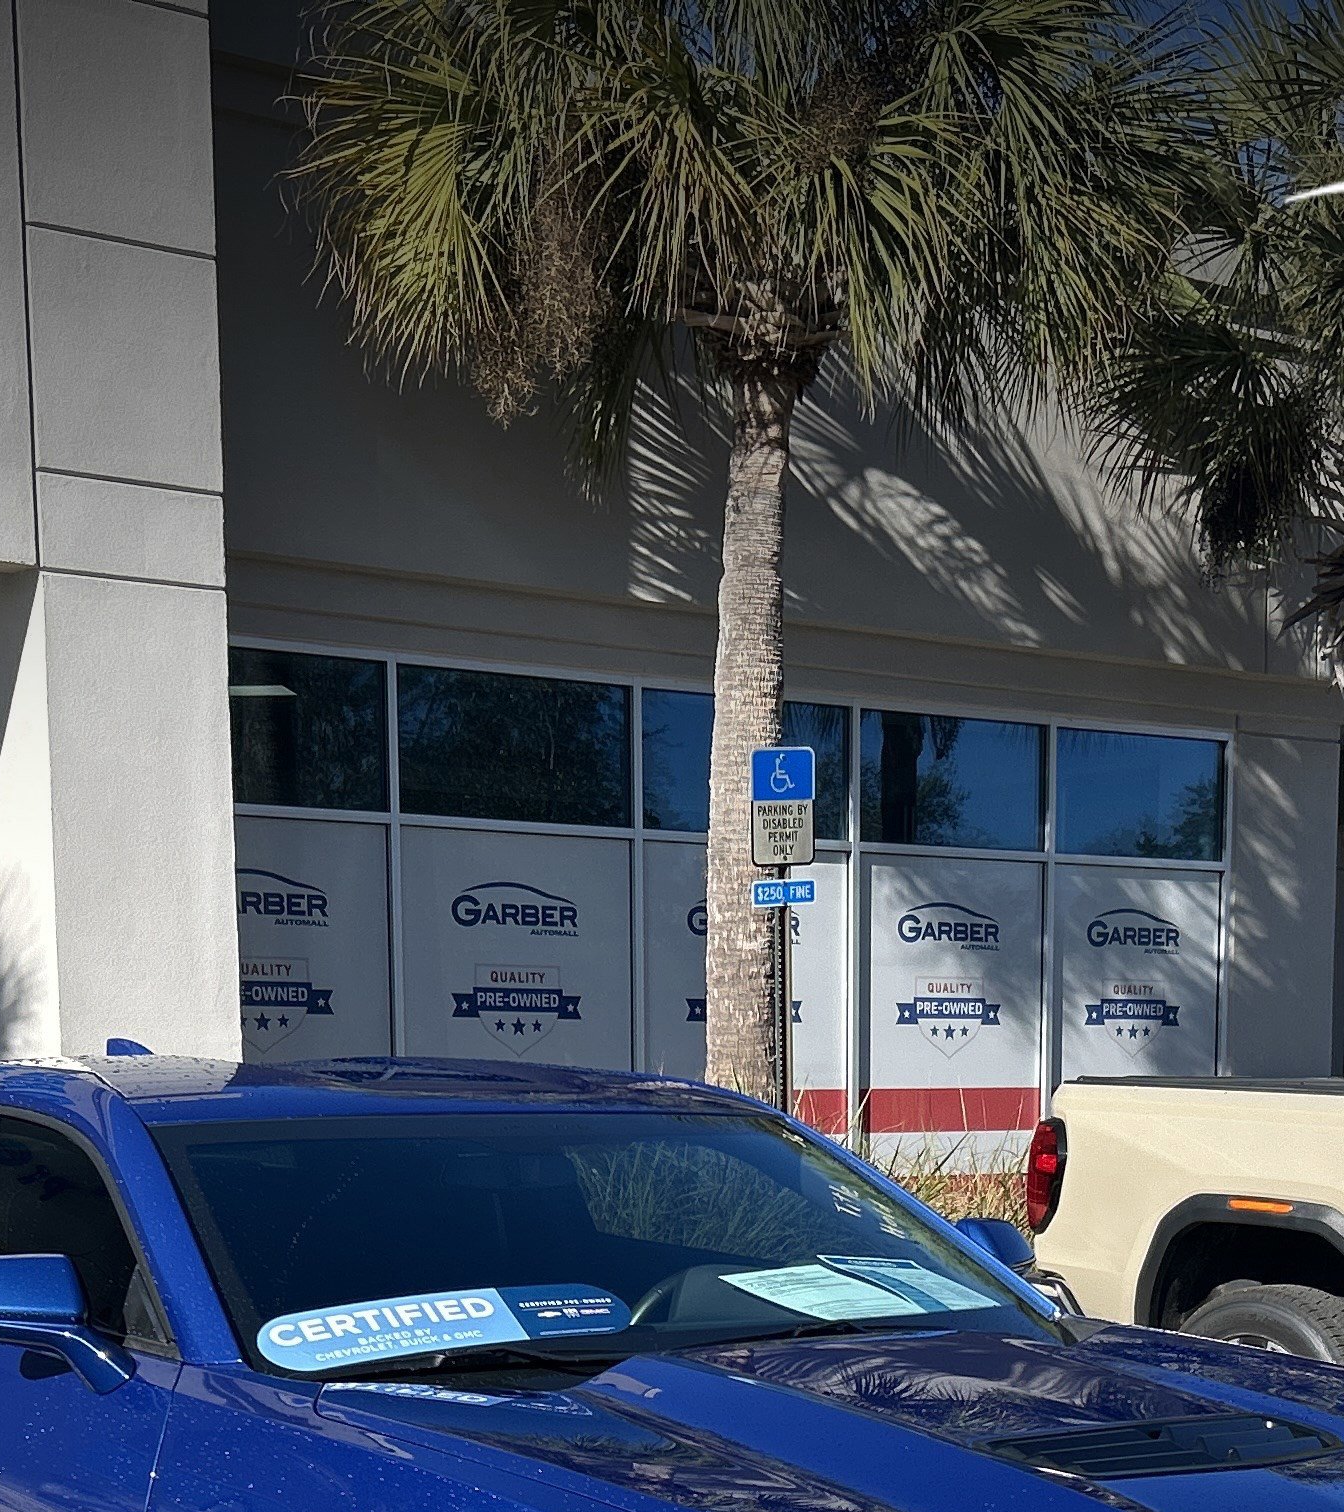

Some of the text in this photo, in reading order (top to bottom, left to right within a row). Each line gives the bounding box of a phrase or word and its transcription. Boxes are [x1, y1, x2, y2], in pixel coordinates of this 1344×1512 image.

[757, 804, 809, 817] PARKING BY
[762, 818, 804, 830] DISABLED
[768, 831, 799, 843] PERMIT
[772, 844, 795, 856] ONLY
[237, 890, 329, 918] RBER
[451, 894, 579, 928] GARBER
[274, 917, 330, 928] AUTOMALL
[897, 914, 1000, 944] GARBER
[529, 927, 580, 938] AUTOMALL
[1086, 919, 1181, 948] GARBER
[489, 970, 547, 985] QUALITY
[926, 981, 974, 995] QUALITY
[1112, 983, 1155, 996] QUALITY
[476, 992, 560, 1009] PRE-OWNED
[915, 1000, 984, 1016] PRE-OWNED
[1101, 1002, 1165, 1018] PRE-OWNED
[268, 1296, 496, 1348] CERTIFIED
[357, 1327, 433, 1346] BACKED BY
[401, 1334, 441, 1350] BUICK
[442, 1332, 453, 1343] &
[453, 1328, 484, 1342] GMC
